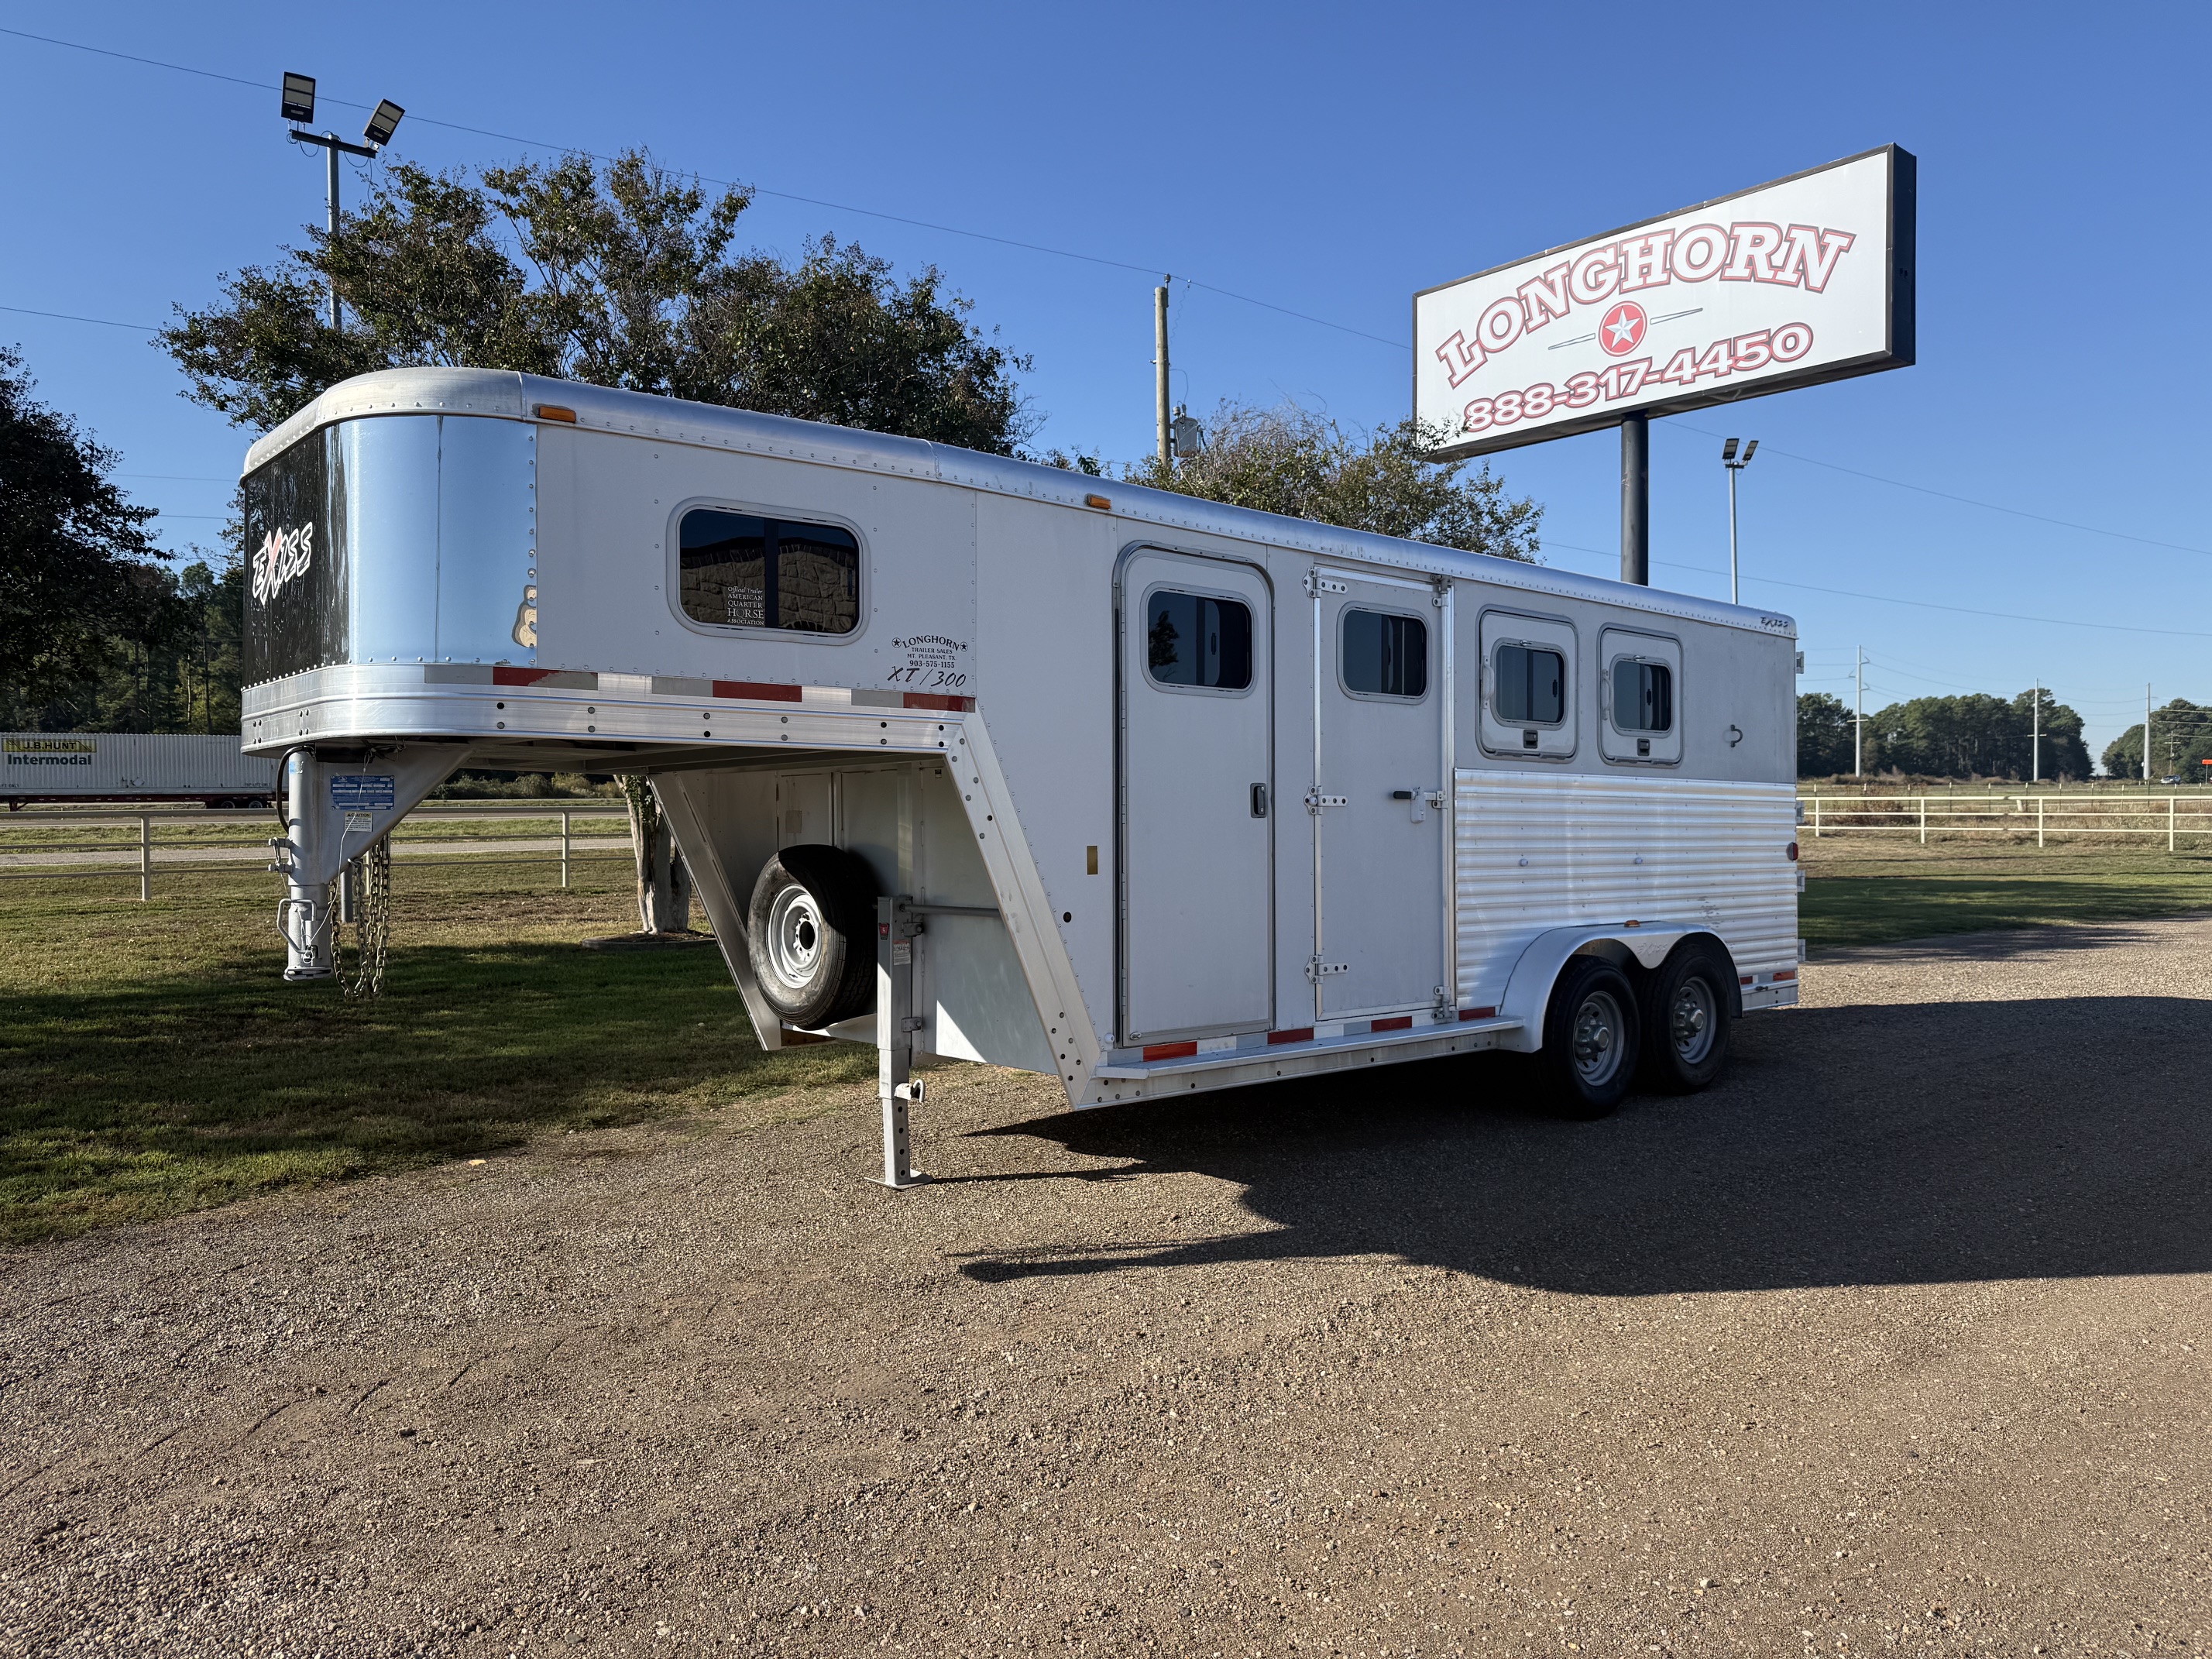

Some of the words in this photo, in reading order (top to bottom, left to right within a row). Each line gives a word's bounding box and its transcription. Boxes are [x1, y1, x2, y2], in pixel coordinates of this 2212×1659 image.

[1437, 222, 1856, 389] LONGHORN
[1464, 322, 1814, 432] 888-317-4450
[252, 521, 313, 605] EXISS
[728, 600, 763, 609] QUARTER
[902, 635, 960, 651] LONGHORN
[909, 660, 955, 668] 903-575-1155
[7, 754, 91, 765] Intermodal
